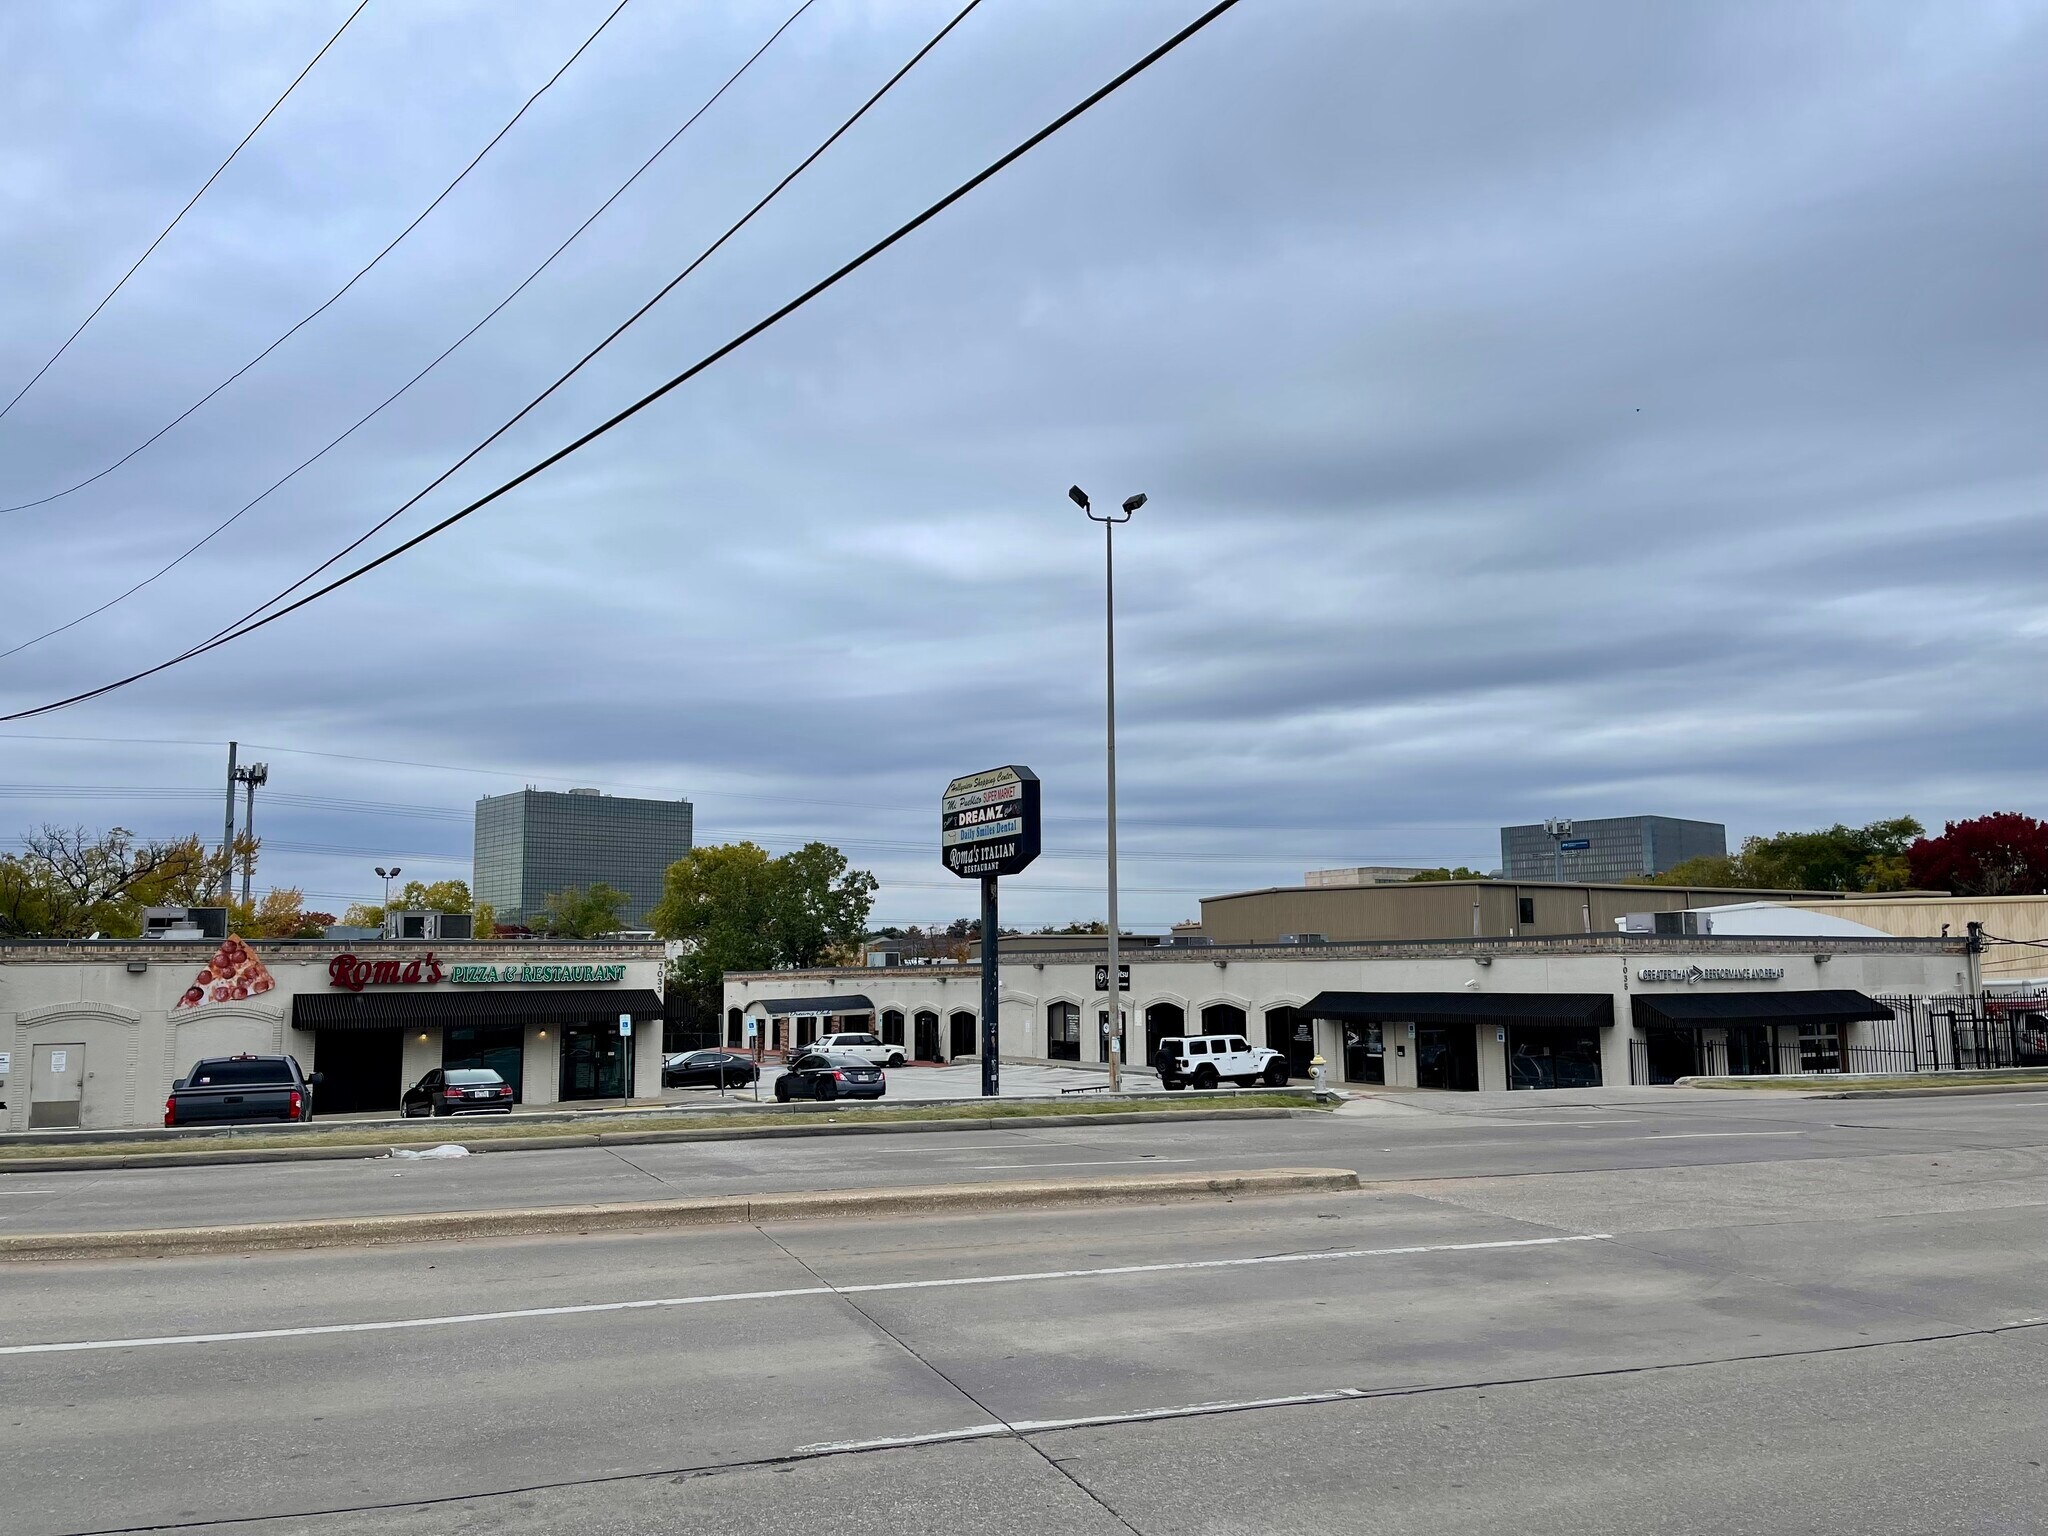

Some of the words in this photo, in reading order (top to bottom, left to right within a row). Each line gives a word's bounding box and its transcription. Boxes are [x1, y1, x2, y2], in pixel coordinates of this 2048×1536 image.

[974, 778, 996, 789] Shopping
[997, 771, 1013, 782] Center
[958, 805, 1004, 826] DREAMZ
[960, 829, 975, 840] Daily
[976, 825, 995, 837] Smiles
[996, 820, 1017, 833] Dental
[949, 844, 980, 870] Roma's
[981, 842, 1015, 861] ITALIAN
[964, 861, 1000, 874] RESTAURANT
[329, 952, 444, 992] Roma's
[451, 965, 499, 983] PIZZA
[504, 966, 518, 983] &
[521, 965, 626, 982] RESTAURANT
[1640, 968, 1671, 980] GREATER
